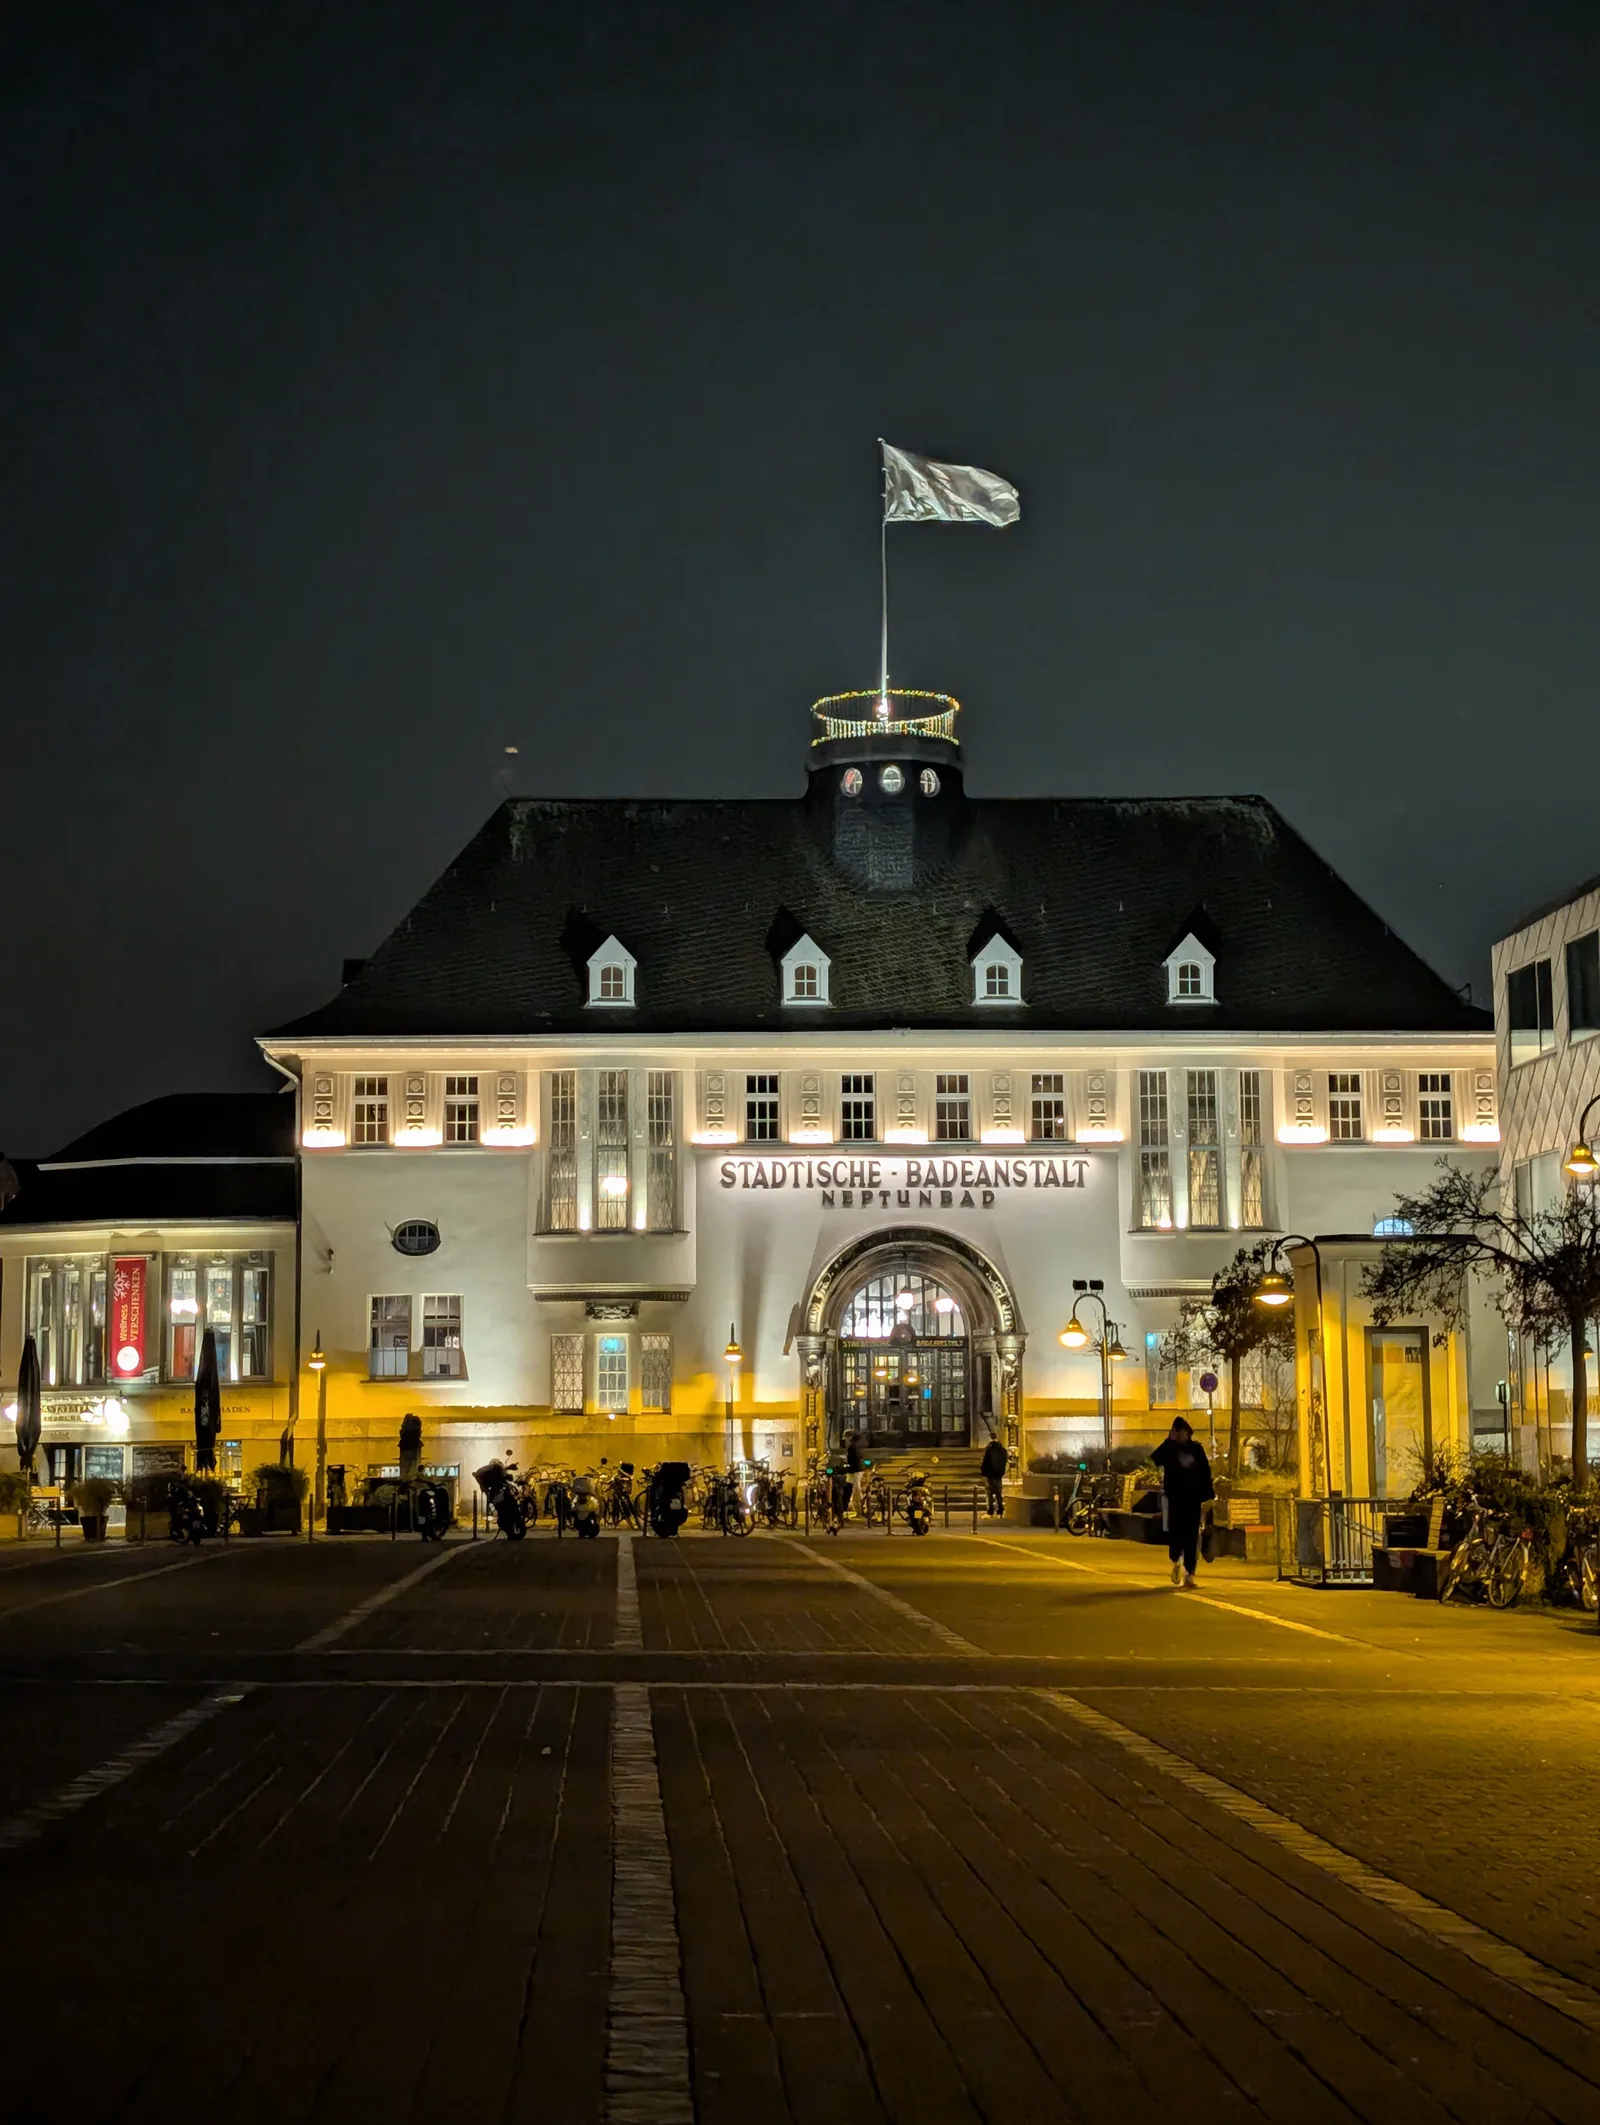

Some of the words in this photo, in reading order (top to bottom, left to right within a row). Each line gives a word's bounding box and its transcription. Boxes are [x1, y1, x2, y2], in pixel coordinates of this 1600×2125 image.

[905, 1160, 1090, 1188] BADEANSTALT
[822, 1189, 996, 1208] NEPTUNBAD
[130, 1267, 141, 1342] VERSCHENKEN
[119, 1304, 129, 1342] Wellness
